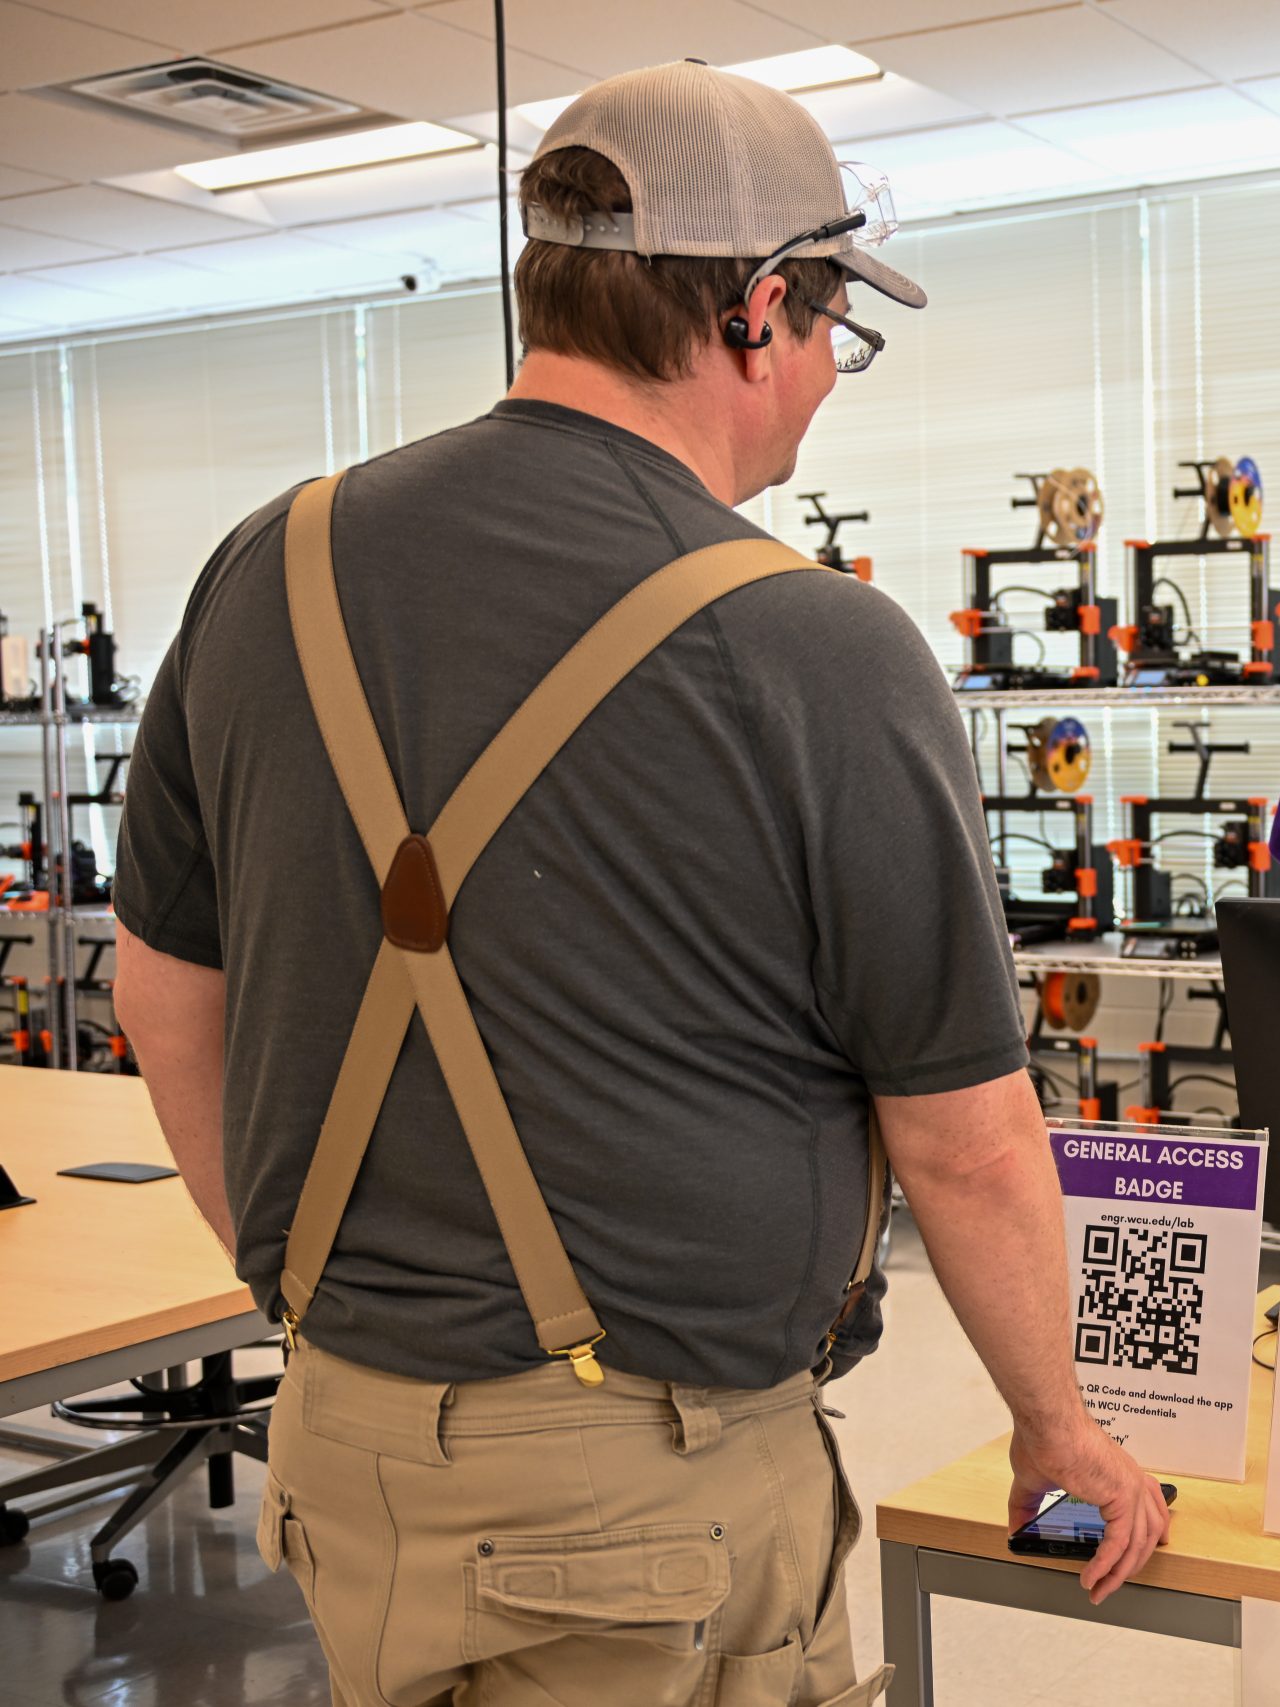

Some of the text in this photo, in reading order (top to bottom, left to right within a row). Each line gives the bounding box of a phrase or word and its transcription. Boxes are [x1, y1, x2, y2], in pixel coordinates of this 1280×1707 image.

[1063, 1139, 1244, 1170] GENERAL ACCESS
[1114, 1176, 1184, 1200] BADGE
[1100, 1213, 1195, 1229] engr.wcu.edu/lab
[1086, 1383, 1100, 1393] QR
[1102, 1385, 1126, 1397] Code
[1128, 1389, 1147, 1399] and
[1148, 1390, 1195, 1405] download
[1197, 1396, 1212, 1407] the
[1214, 1401, 1233, 1412] app
[1098, 1400, 1121, 1411] WCU
[1123, 1403, 1177, 1419] Credentials
